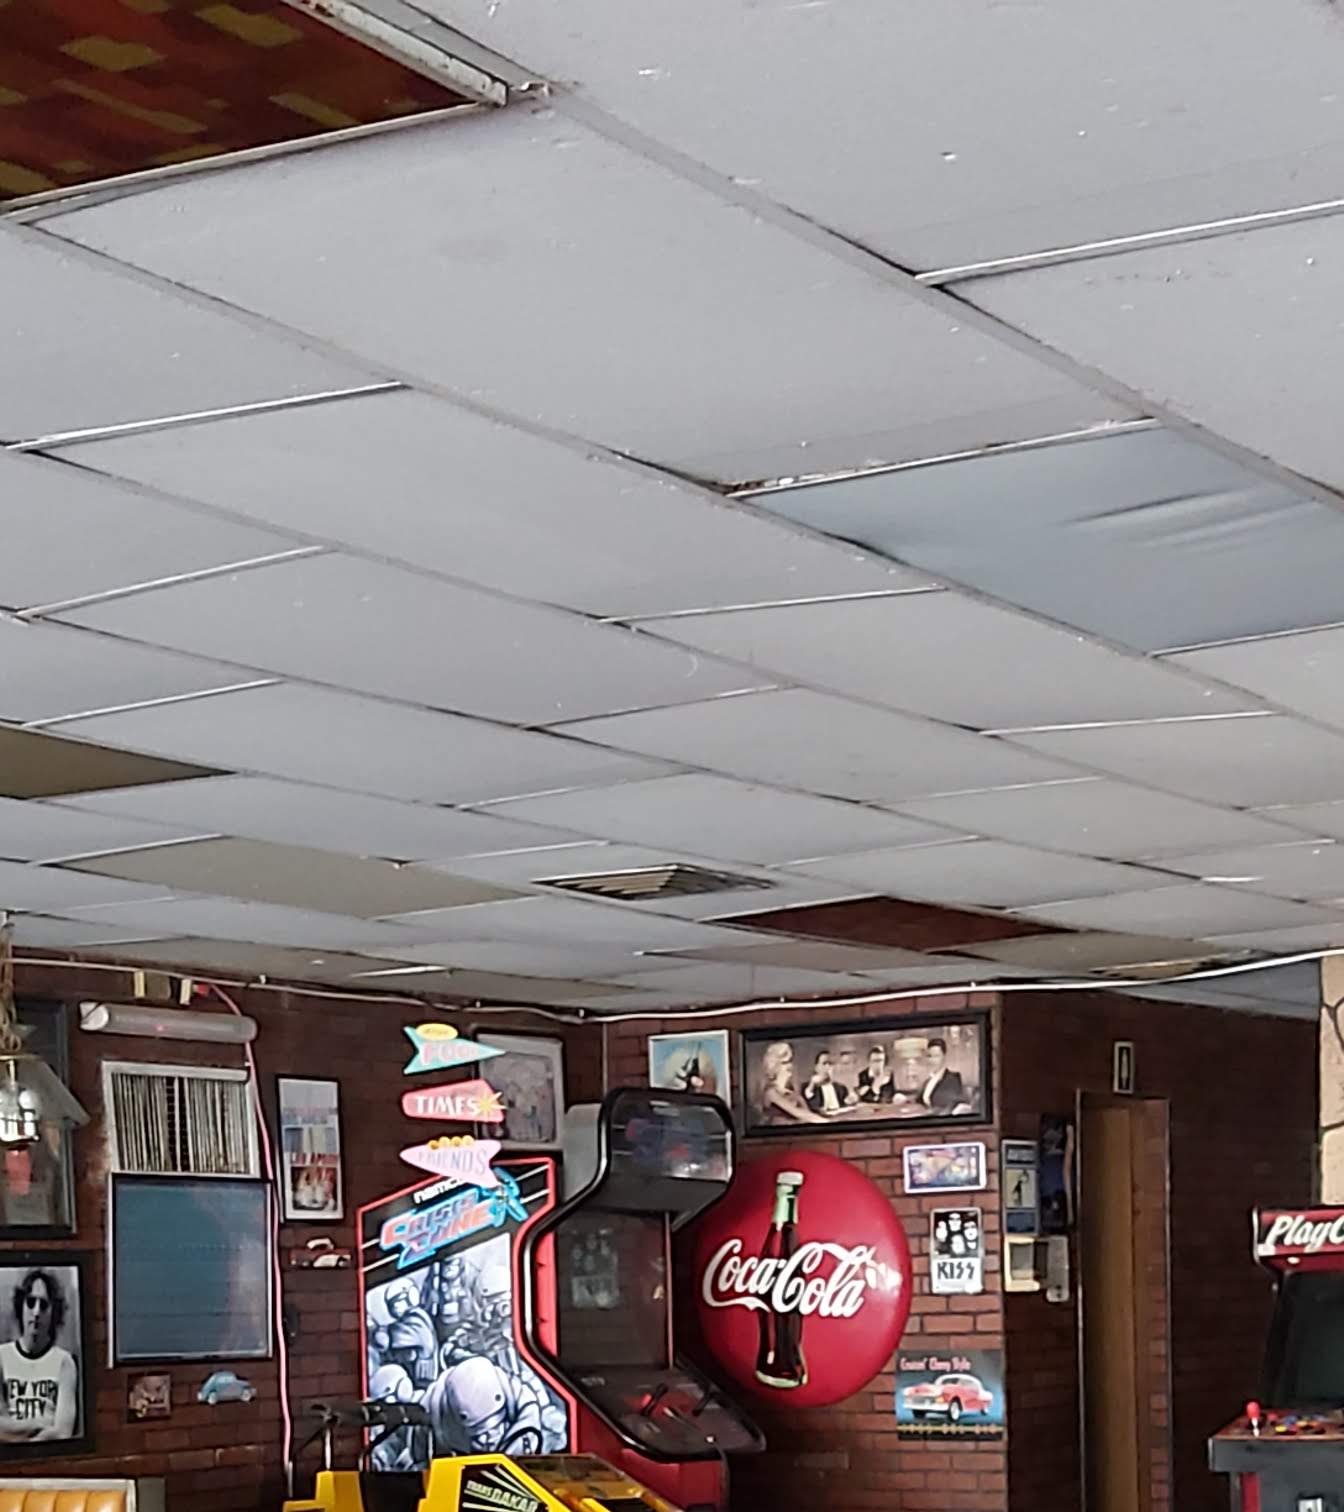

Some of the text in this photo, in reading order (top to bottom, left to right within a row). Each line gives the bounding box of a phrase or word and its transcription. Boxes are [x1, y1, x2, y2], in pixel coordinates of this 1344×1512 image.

[414, 1096, 482, 1117] TIMES
[702, 1238, 868, 1318] Coca-Cola
[937, 1261, 975, 1280] KISS
[16, 1398, 47, 1420] CITY
